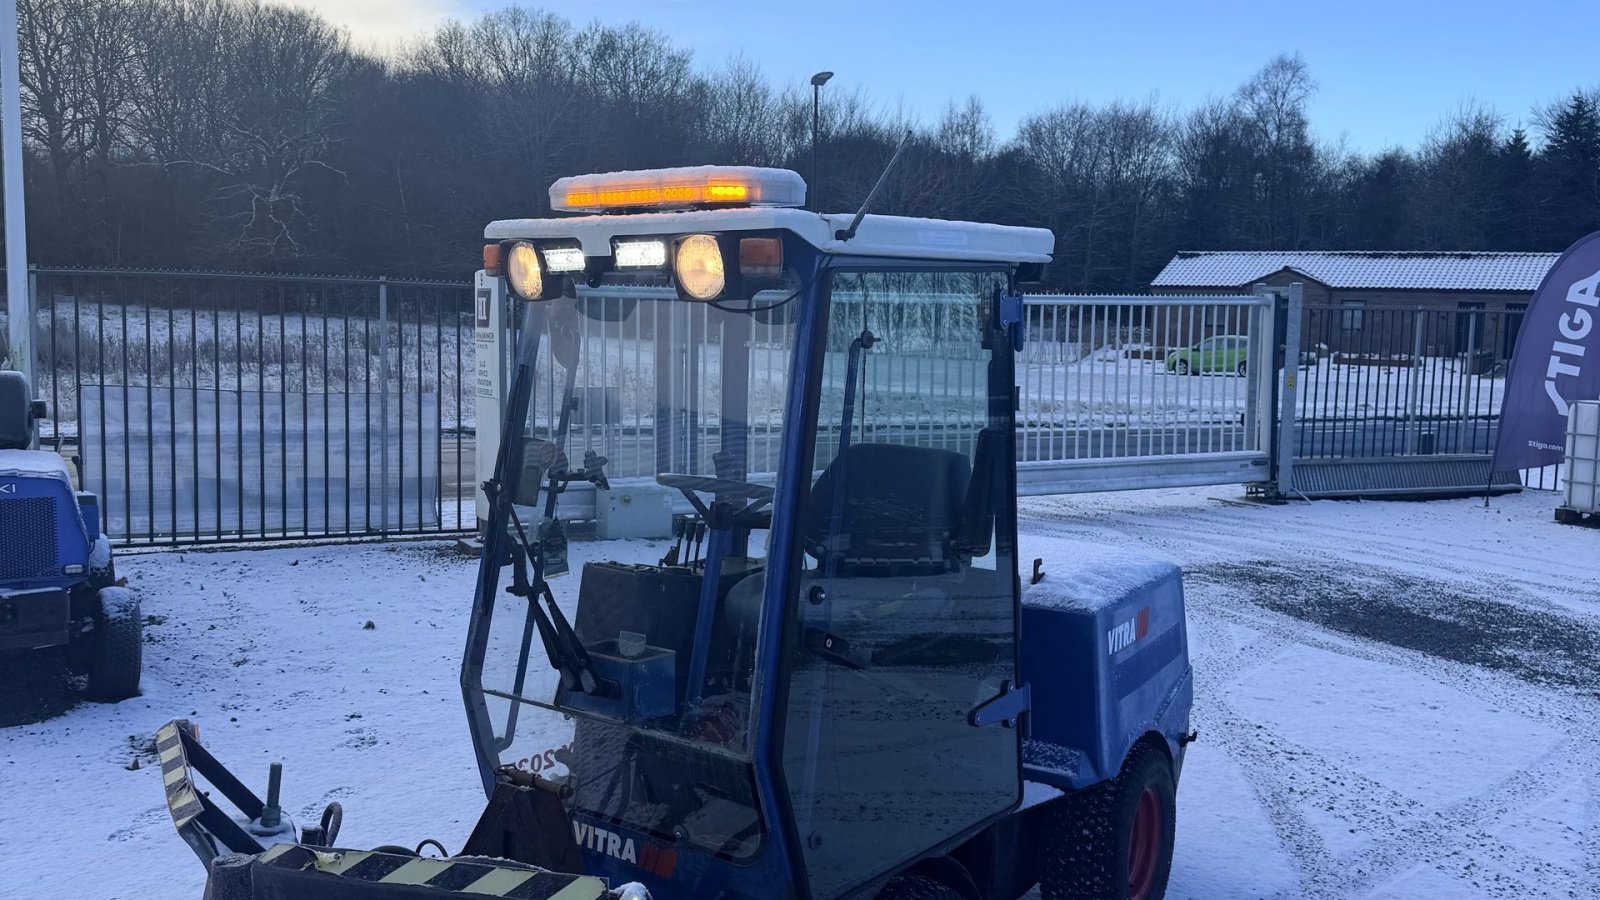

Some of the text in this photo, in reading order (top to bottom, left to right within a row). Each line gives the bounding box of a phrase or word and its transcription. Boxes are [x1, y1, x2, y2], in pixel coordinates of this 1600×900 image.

[1545, 270, 1600, 416] STIGA
[1528, 440, 1564, 452] Stiga.com
[1107, 617, 1136, 655] VITRA
[572, 820, 637, 865] VITRA
